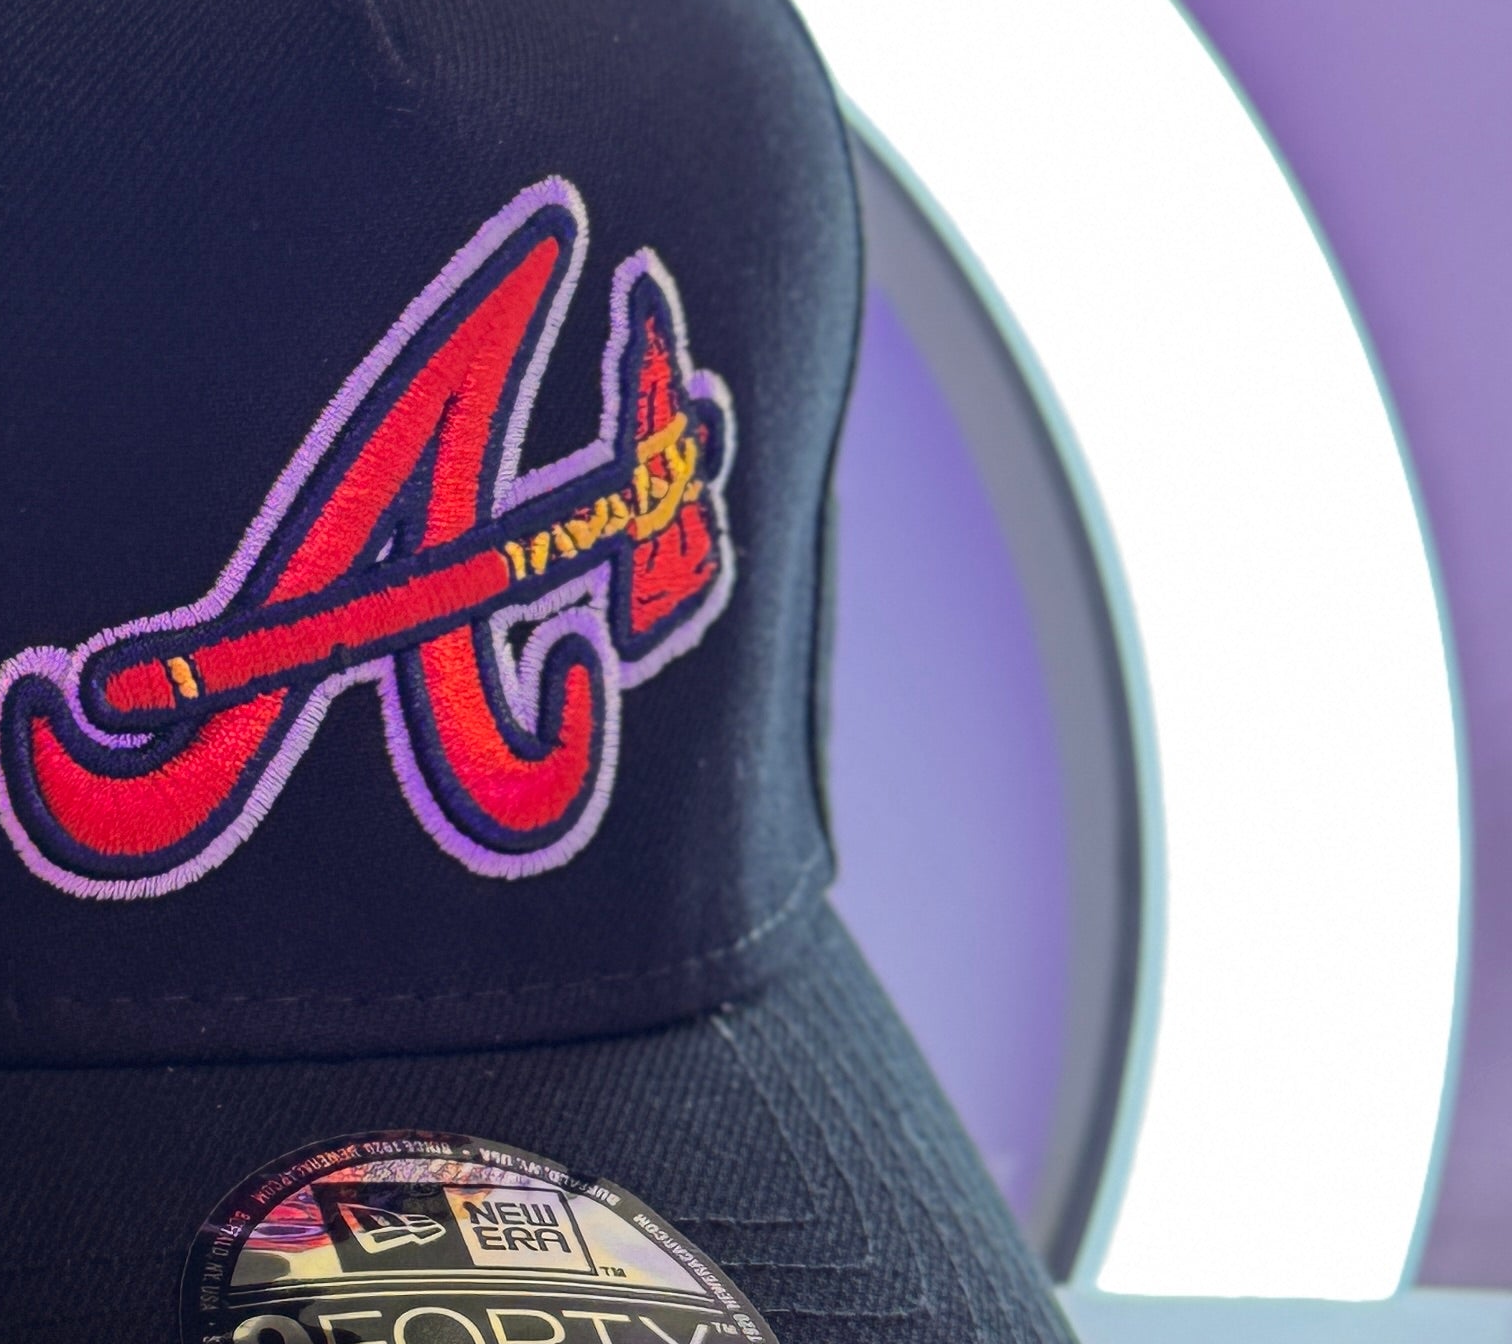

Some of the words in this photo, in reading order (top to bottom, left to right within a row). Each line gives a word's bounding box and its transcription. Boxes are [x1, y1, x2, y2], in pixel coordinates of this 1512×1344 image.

[462, 1201, 559, 1228] NEW
[472, 1226, 572, 1254] ERA
[199, 1285, 221, 1312] USA
